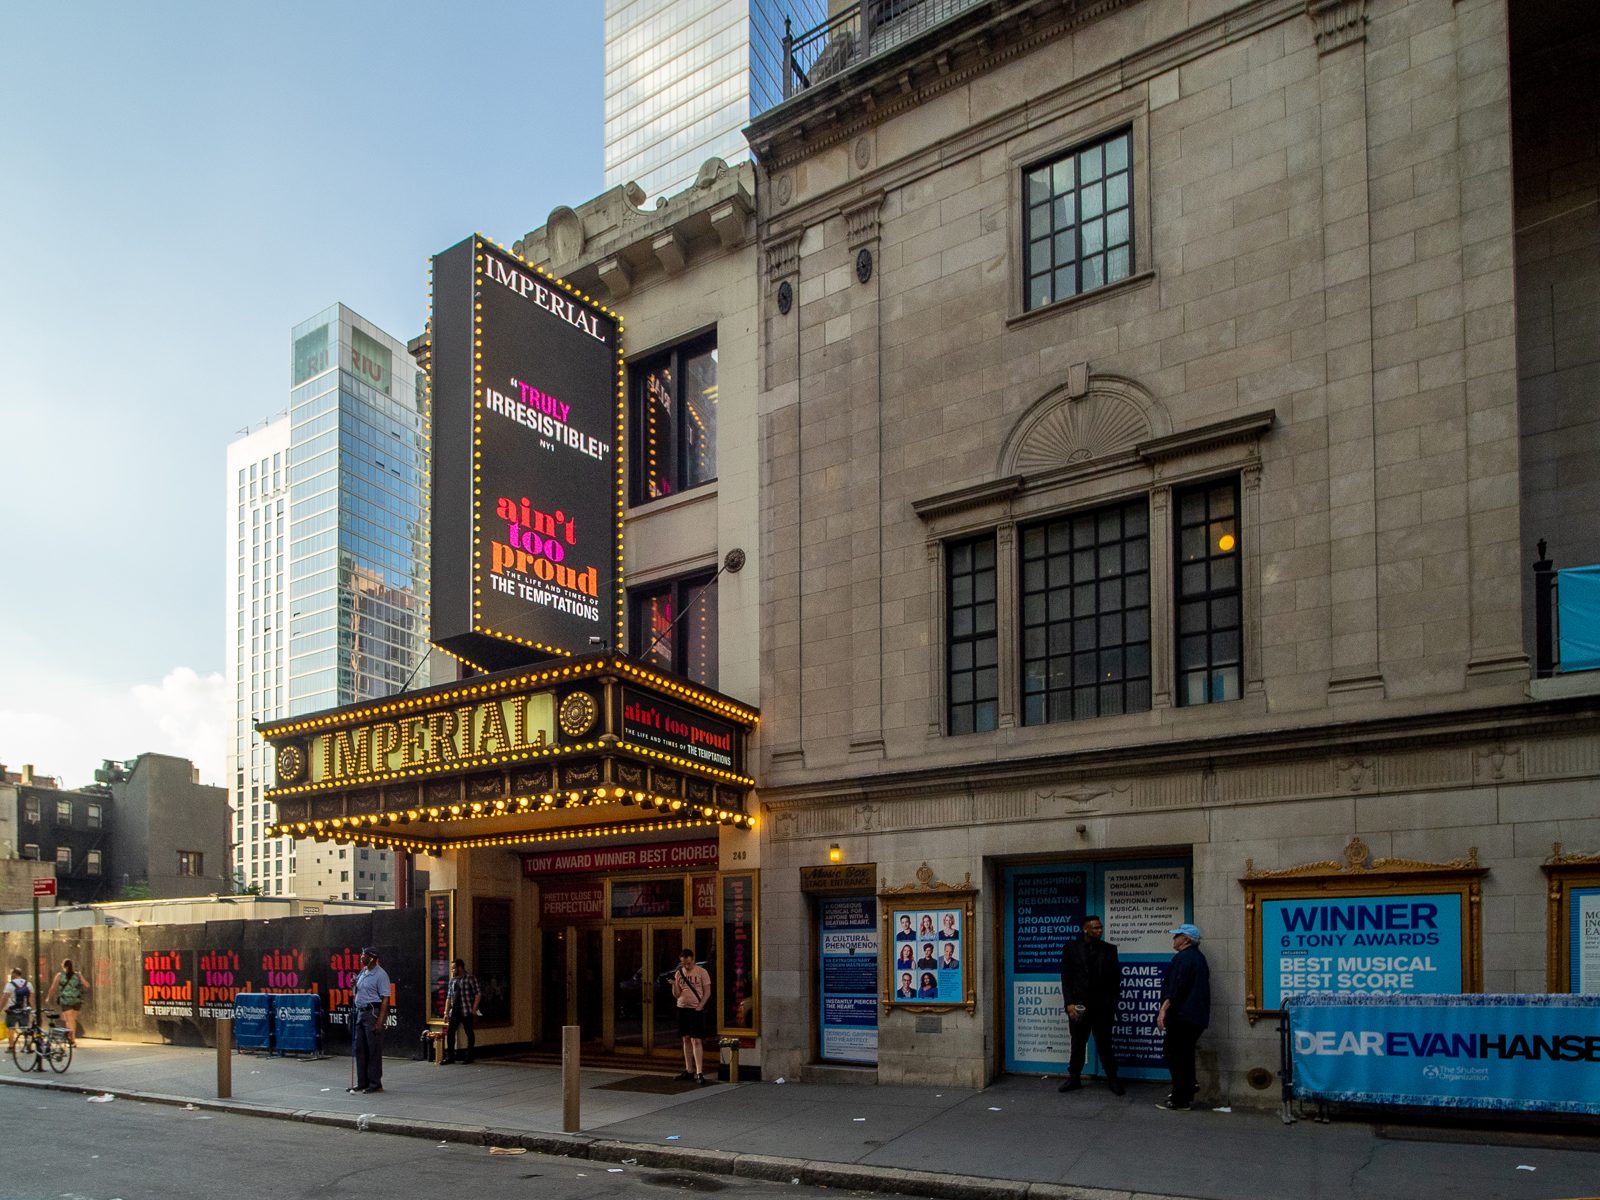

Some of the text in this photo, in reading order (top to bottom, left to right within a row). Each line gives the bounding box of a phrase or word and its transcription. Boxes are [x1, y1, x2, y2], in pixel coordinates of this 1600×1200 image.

[485, 253, 606, 342] IMPERIAL
[352, 348, 383, 382] RIU
[539, 438, 555, 452] NY1
[496, 497, 576, 545] ain't
[508, 521, 565, 562] too
[490, 540, 598, 598] proud
[506, 570, 599, 606] THE LIFE AND TIMES OF
[490, 574, 599, 622] THE TEMPTATIONS
[624, 702, 730, 751] ain't too proud
[320, 695, 545, 781] IMPERIAL
[625, 727, 635, 736] THE
[637, 731, 649, 740] LIFE
[663, 739, 678, 748] TIMES
[687, 744, 698, 757] THE
[698, 747, 731, 766] TEMPTATIONS
[526, 844, 718, 872] TONY AWARD WINNER BEST CHOREO
[733, 851, 746, 860] 249
[570, 890, 592, 901] CLOSE
[1018, 887, 1057, 895] ANTHEM
[1018, 896, 1079, 905] RESONATING
[1018, 907, 1032, 915] ON
[1281, 903, 1438, 932] WINNER
[1018, 915, 1071, 924] BROADWAY
[1018, 925, 1082, 933] AND BEYOND.
[1281, 932, 1439, 947] 6 TONY AWARDS
[144, 951, 181, 971] ain't
[200, 949, 240, 971] ain't
[261, 947, 305, 971] ain't
[1280, 956, 1437, 972] BEST MUSICAL
[149, 970, 176, 986] too
[205, 970, 234, 987] too
[1122, 966, 1163, 976] GAME-
[267, 970, 299, 988] too
[1119, 978, 1164, 988] HANGE
[1280, 973, 1414, 988] BEST SCORE
[143, 980, 192, 1005] proud
[1119, 990, 1140, 999] HAT
[1018, 997, 1042, 1005] AND
[1118, 1001, 1135, 1011] OU
[144, 1005, 193, 1017] THE TEMPTATIONS
[199, 1007, 211, 1018] THE
[329, 1013, 343, 1024] THE
[1018, 1007, 1065, 1016] BEAUTIF
[1121, 1013, 1156, 1023] SHOT
[1294, 1030, 1384, 1056] DEAR
[1386, 1032, 1476, 1058] EVAN
[1439, 1065, 1488, 1074] The Shubert
[1439, 1073, 1489, 1081] Organization
